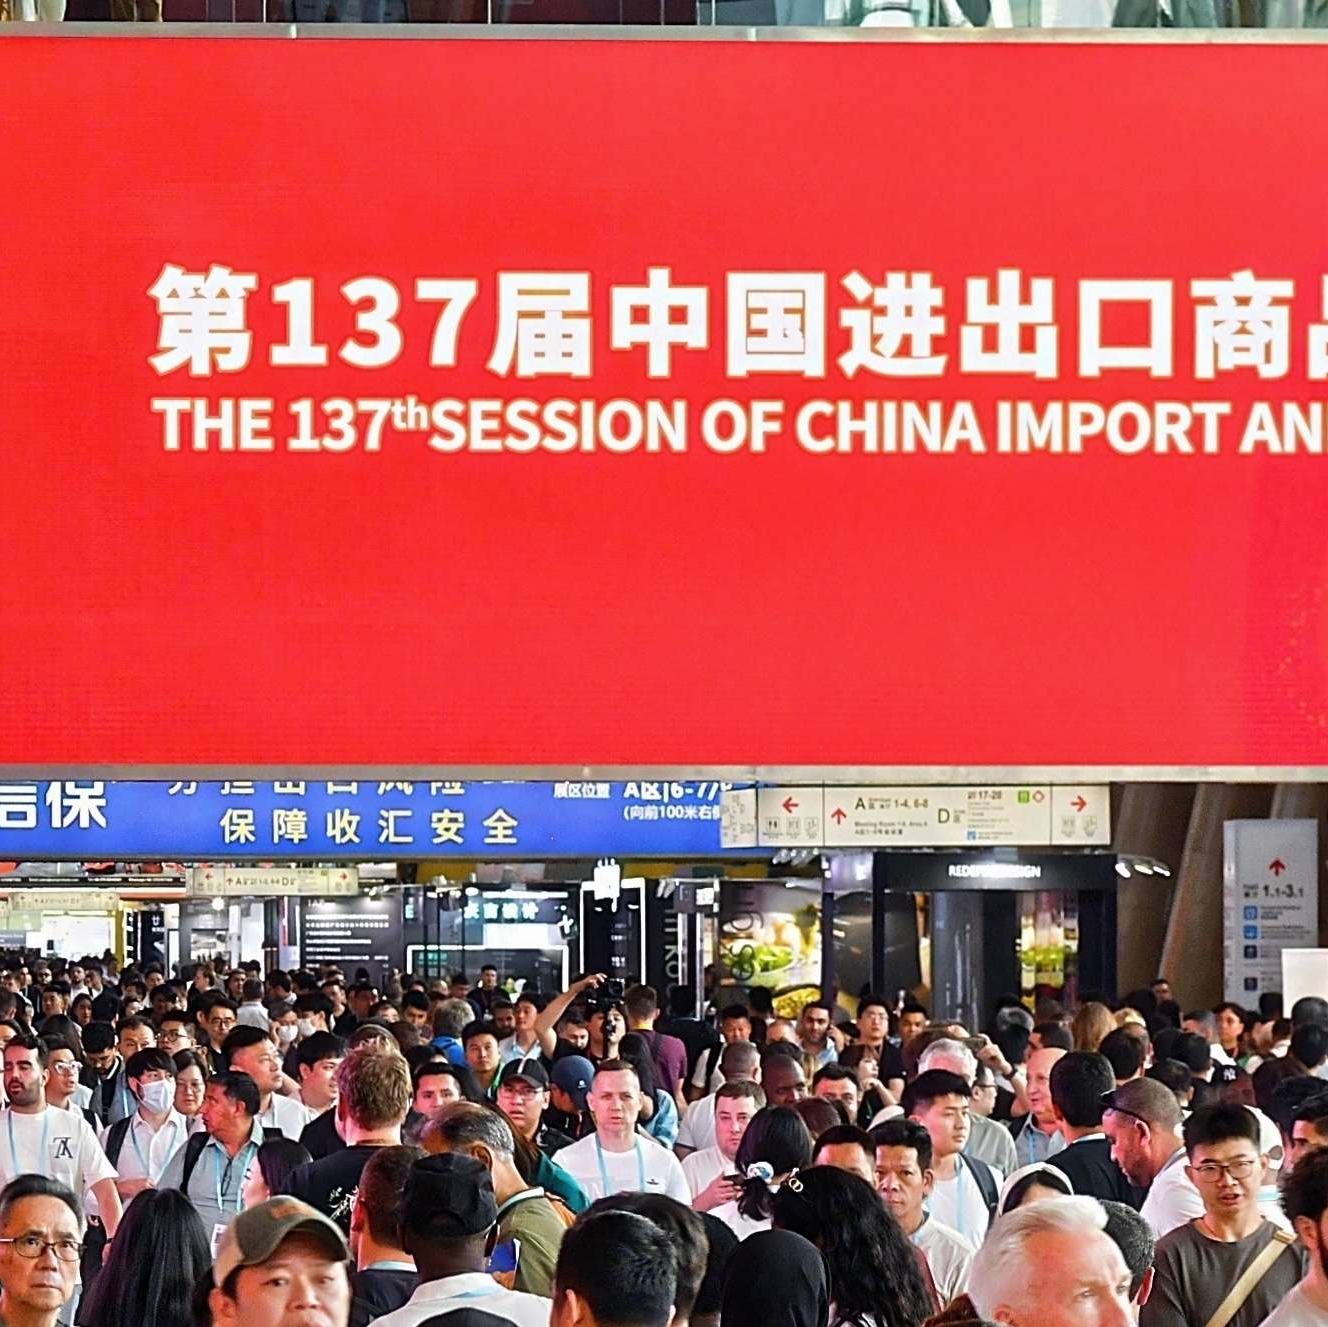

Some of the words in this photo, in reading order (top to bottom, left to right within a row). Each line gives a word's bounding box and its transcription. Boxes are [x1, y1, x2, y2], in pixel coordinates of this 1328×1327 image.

[152, 399, 273, 450] THE
[702, 400, 783, 452] OF
[796, 400, 985, 452] CHINA
[998, 401, 1231, 453] IMPORT
[219, 807, 518, 844] 保障收汇安全
